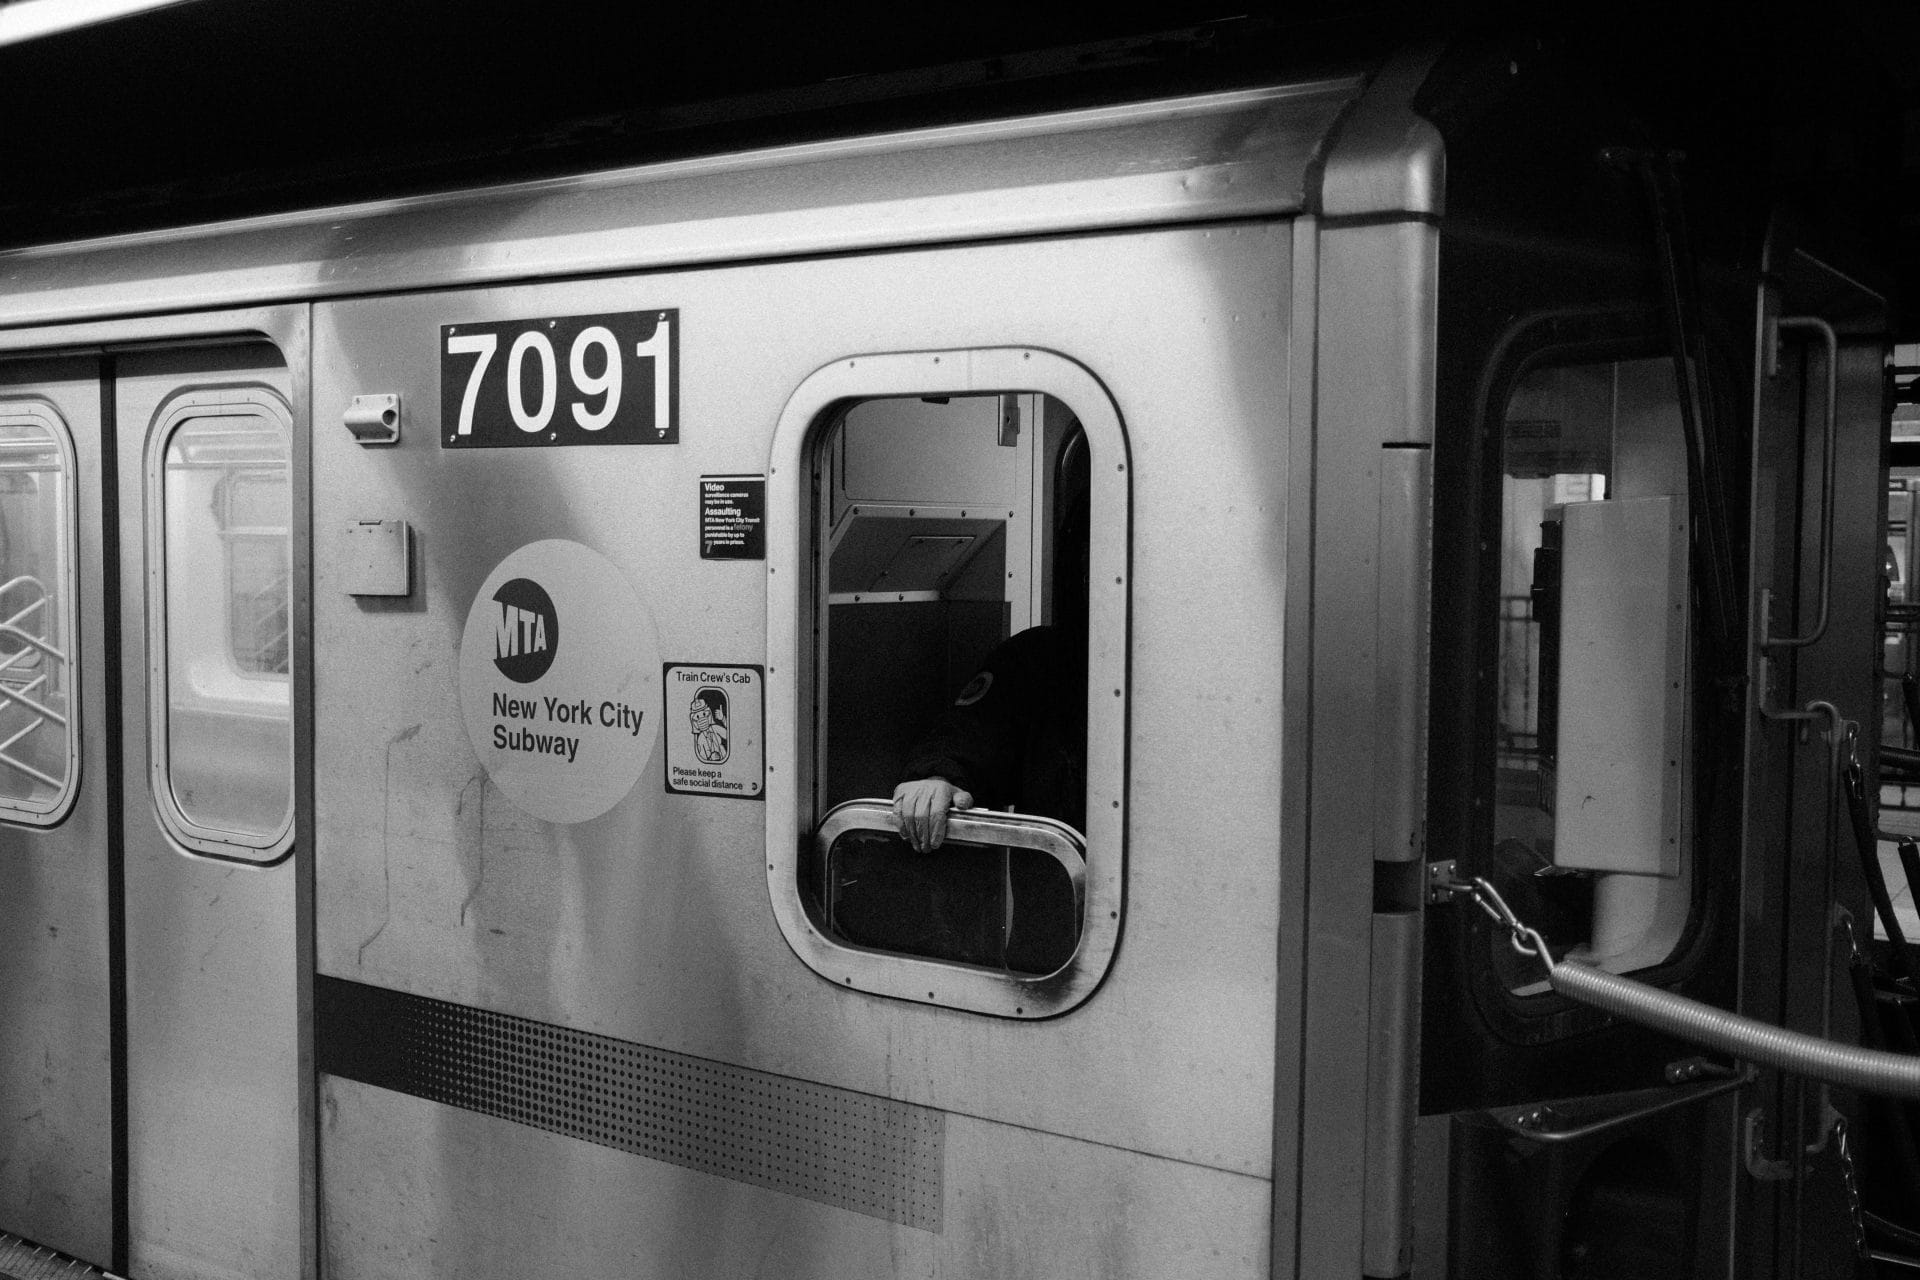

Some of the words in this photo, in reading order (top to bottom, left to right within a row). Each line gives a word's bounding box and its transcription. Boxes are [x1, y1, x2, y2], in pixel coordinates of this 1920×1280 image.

[448, 320, 670, 435] 7091
[704, 483, 725, 491] Video
[704, 507, 741, 517] Assaulting
[734, 523, 753, 532] felony
[705, 541, 713, 554] 7
[492, 599, 547, 664] MTA
[676, 671, 699, 682] Train
[700, 672, 731, 683] Crew's
[732, 673, 751, 684] Cab
[493, 692, 537, 720] New
[543, 696, 593, 725] York
[599, 701, 644, 737] City
[493, 724, 579, 763] Subway
[673, 766, 697, 777] Please
[697, 768, 717, 779] keep
[672, 777, 688, 786] safe
[689, 778, 711, 788] social
[711, 779, 743, 790] distance
